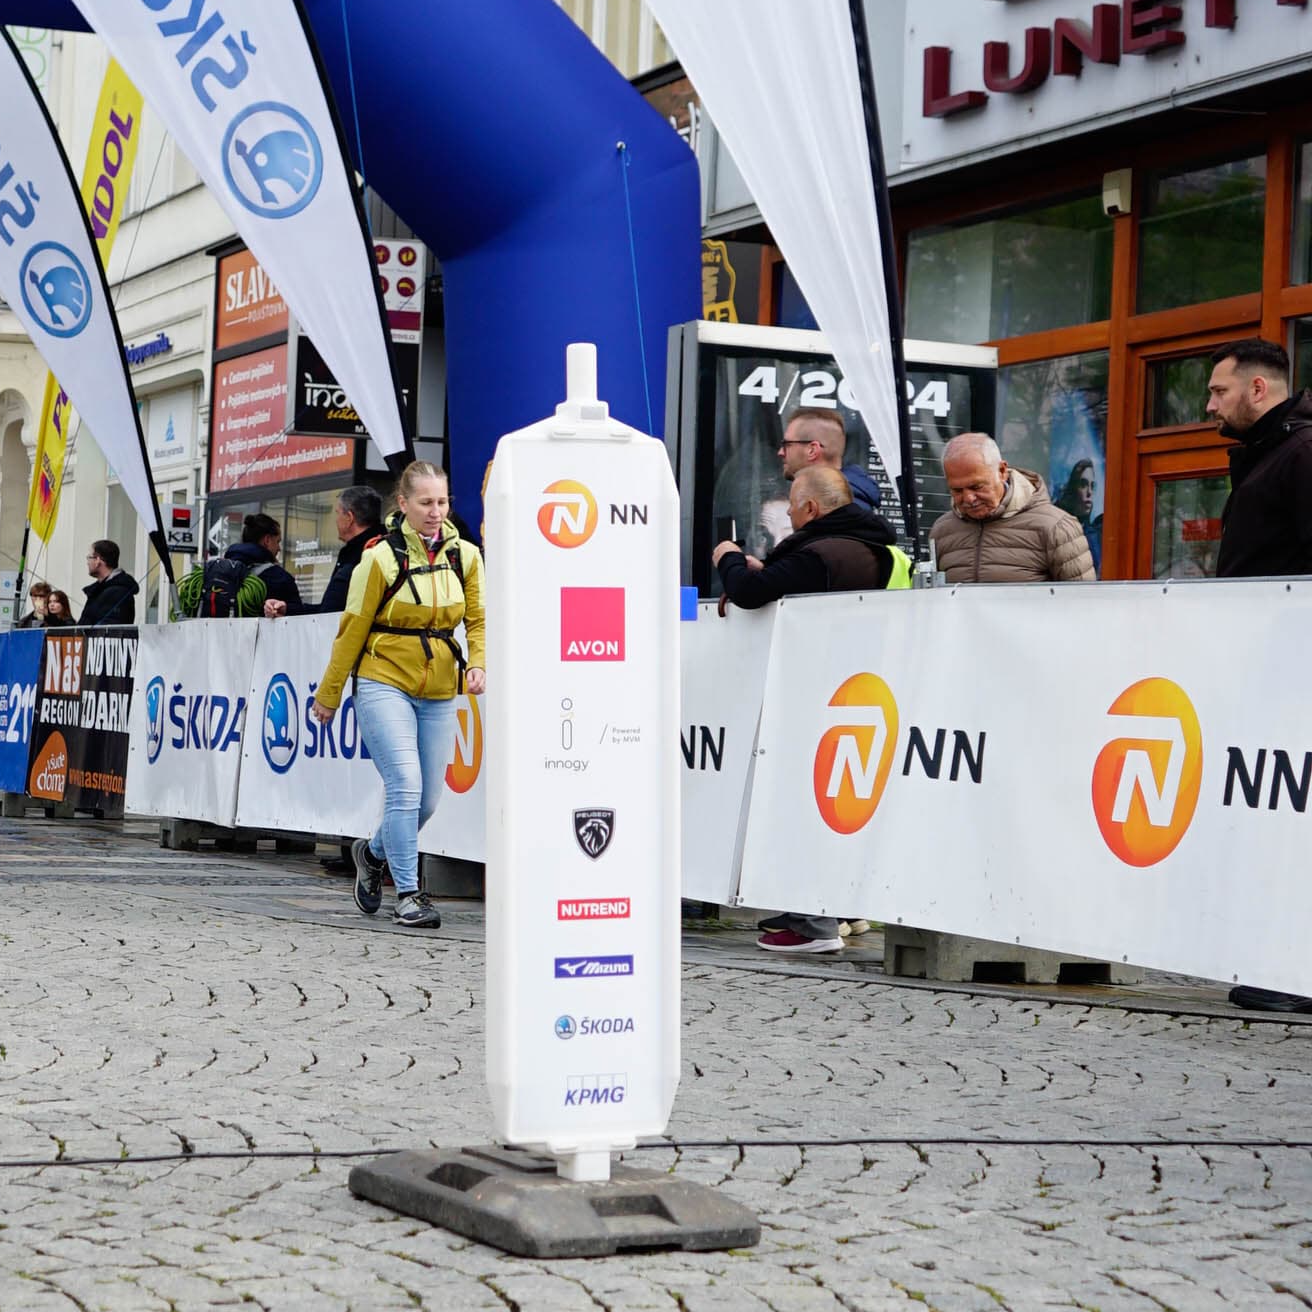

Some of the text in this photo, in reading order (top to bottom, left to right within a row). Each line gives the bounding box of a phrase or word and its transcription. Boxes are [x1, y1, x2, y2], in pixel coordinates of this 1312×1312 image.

[610, 504, 648, 525] NN
[168, 531, 193, 543] KB
[567, 640, 619, 656] AVON
[43, 639, 82, 695] Náš
[40, 697, 80, 727] REGION
[545, 755, 589, 772] innogy
[902, 726, 986, 784] NN
[1223, 745, 1312, 813] NN
[561, 901, 628, 918] NUTREND
[579, 1018, 634, 1036] ŠKODA
[564, 1086, 625, 1107] KPMG
